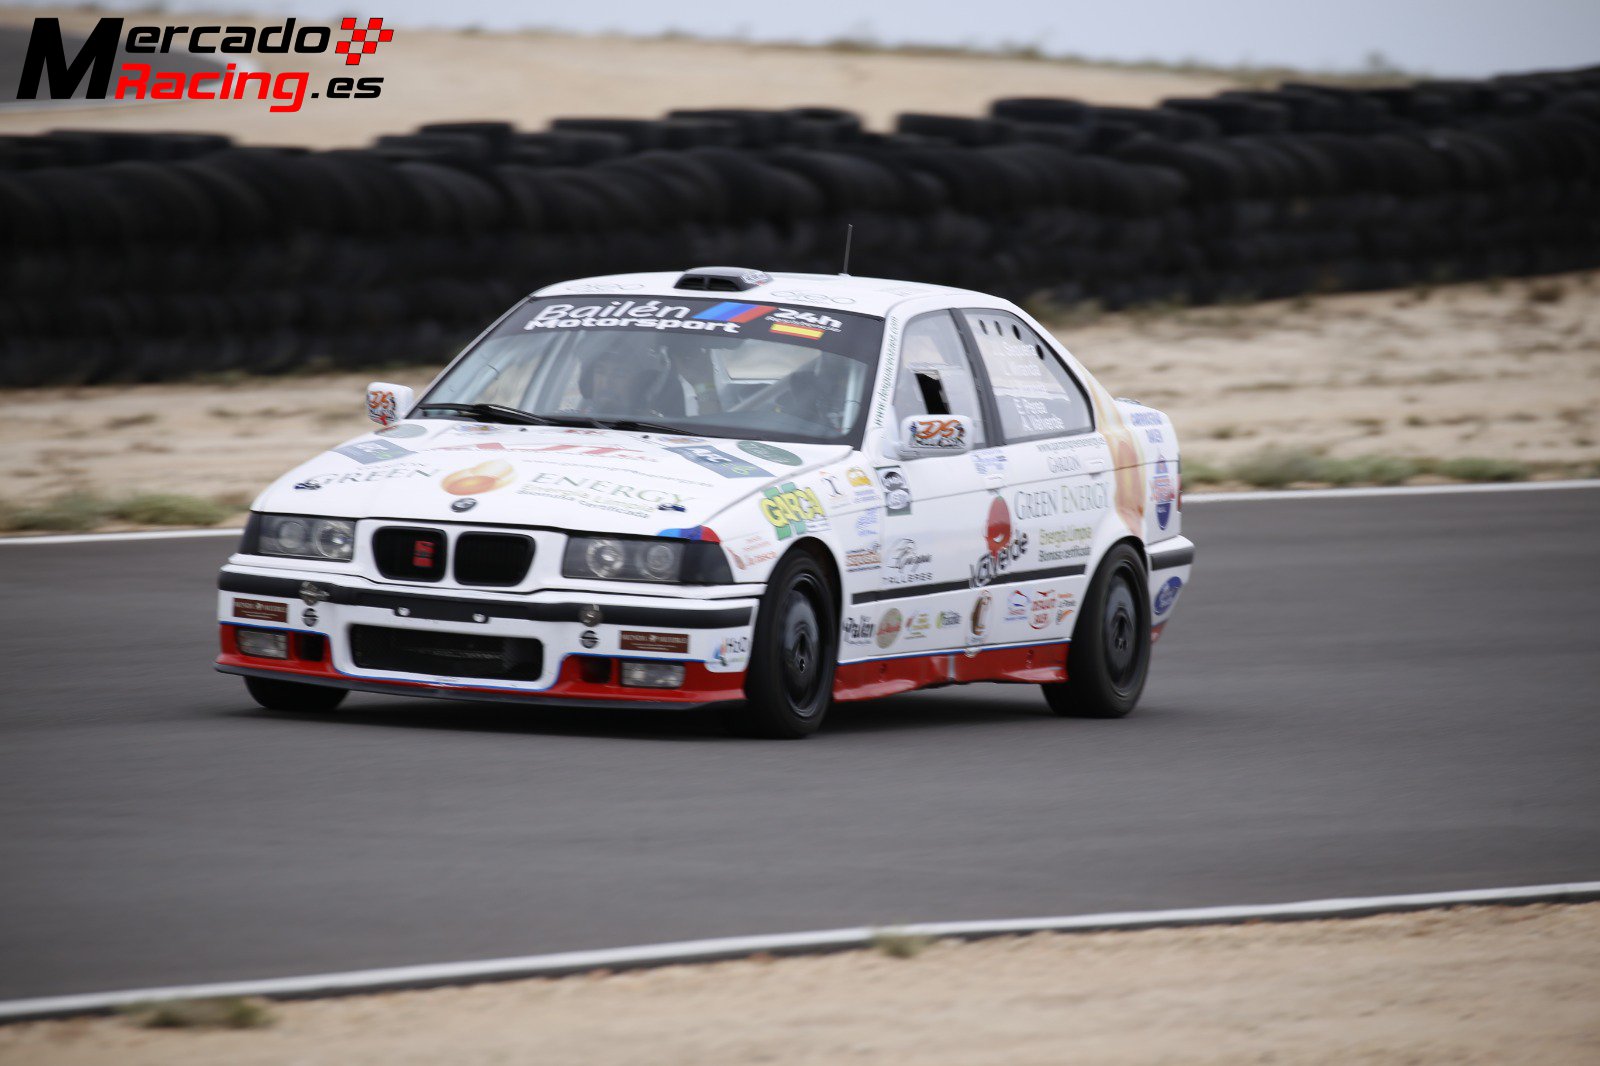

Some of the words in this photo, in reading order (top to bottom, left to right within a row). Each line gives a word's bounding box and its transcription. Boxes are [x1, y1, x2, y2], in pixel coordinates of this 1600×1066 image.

[537, 300, 691, 321] Bailén
[775, 307, 842, 328] 24h
[524, 315, 741, 333] Motorsport
[307, 467, 440, 486] GREEN
[531, 472, 697, 505] ENERGY
[1014, 489, 1058, 520] GREEN
[1061, 482, 1110, 514] ENERGY
